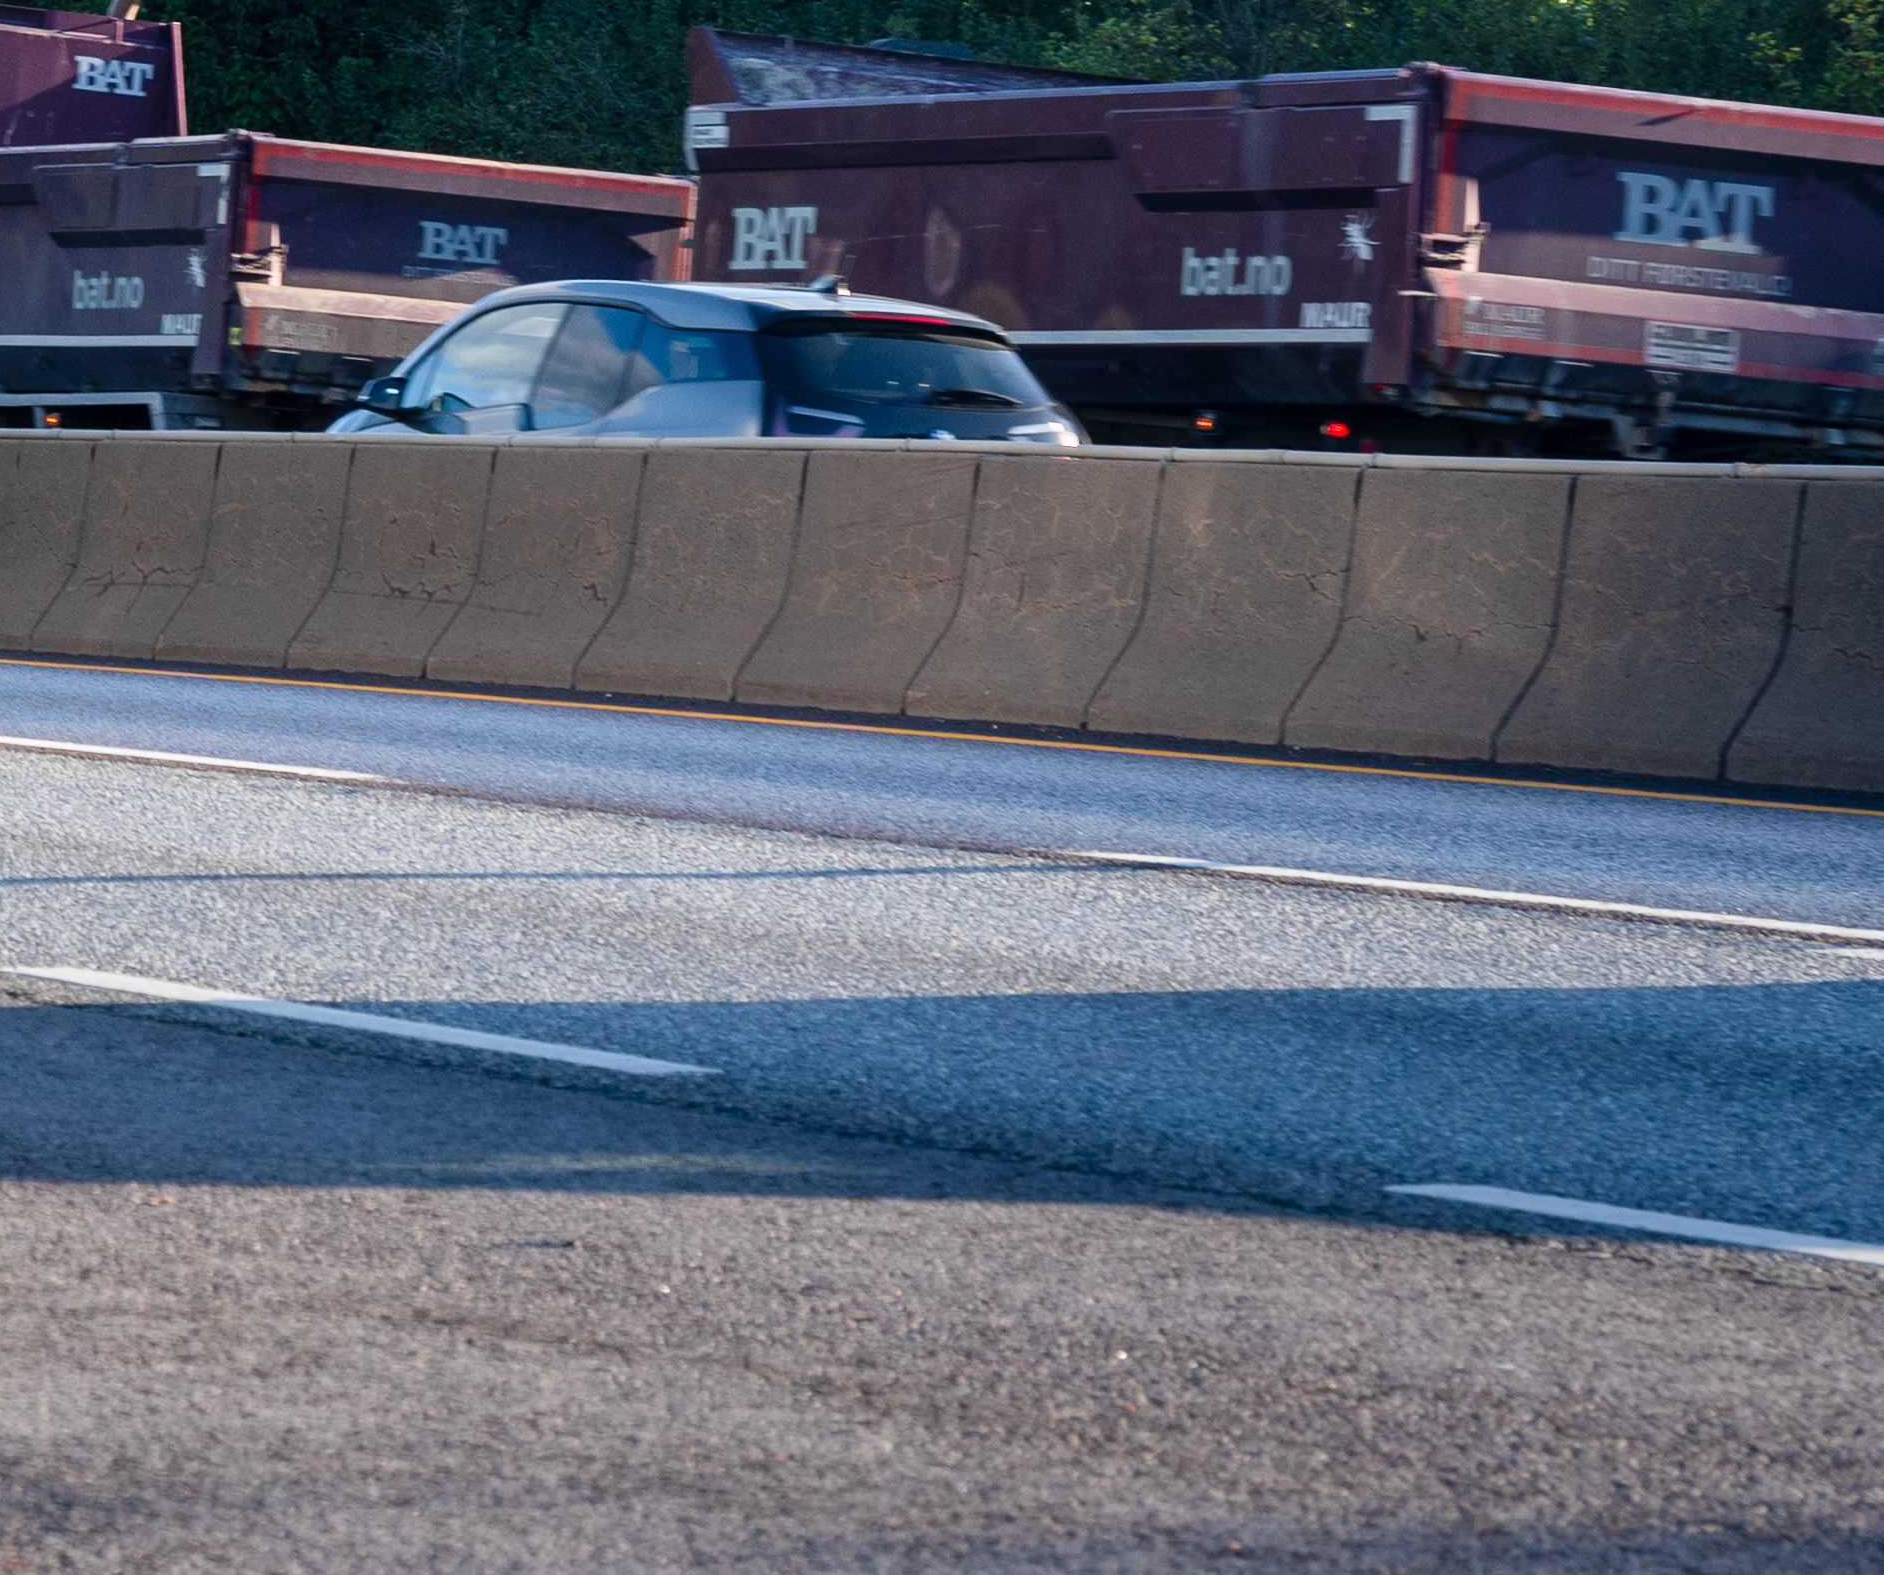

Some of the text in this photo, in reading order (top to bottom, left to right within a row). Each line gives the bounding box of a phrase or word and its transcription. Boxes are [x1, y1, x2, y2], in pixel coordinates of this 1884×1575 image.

[71, 55, 155, 97] BAT
[1612, 171, 1776, 255] BAT
[417, 220, 509, 266] BAT
[728, 206, 819, 270] BAT
[72, 270, 145, 310] bat.no
[1181, 246, 1294, 296] bat.no
[1299, 302, 1373, 328] MAUR
